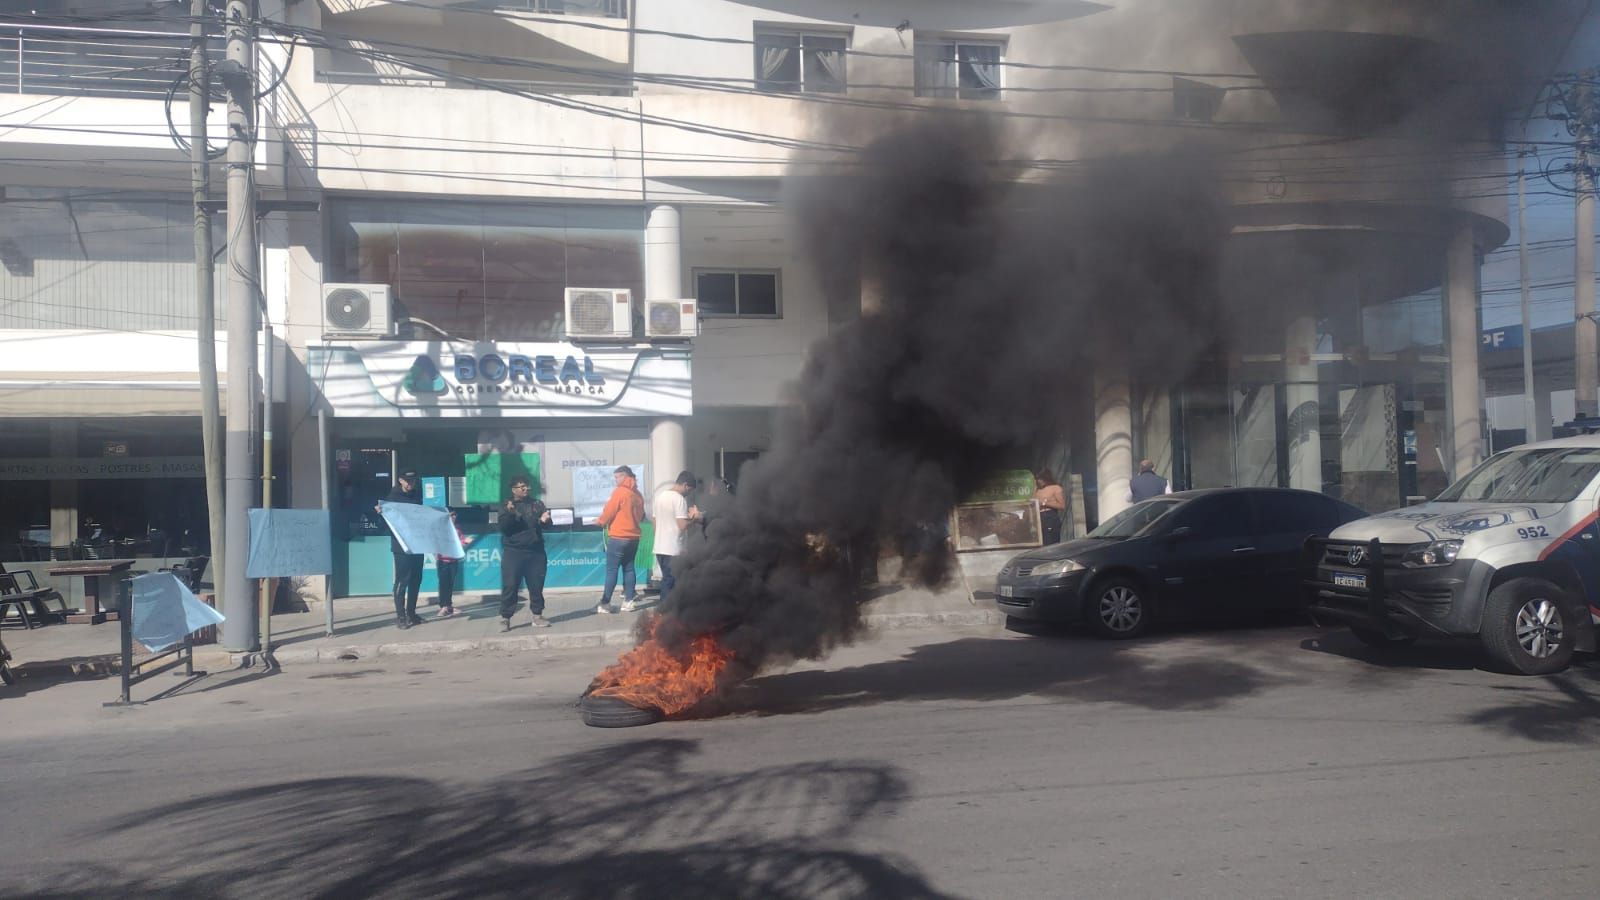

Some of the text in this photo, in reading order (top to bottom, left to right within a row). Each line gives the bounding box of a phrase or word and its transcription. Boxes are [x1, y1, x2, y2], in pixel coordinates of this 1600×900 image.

[454, 353, 607, 385] BOREAL
[99, 463, 151, 473] POSTRES
[561, 459, 608, 469] para vos
[1018, 486, 1031, 495] 00
[1518, 525, 1549, 540] 952
